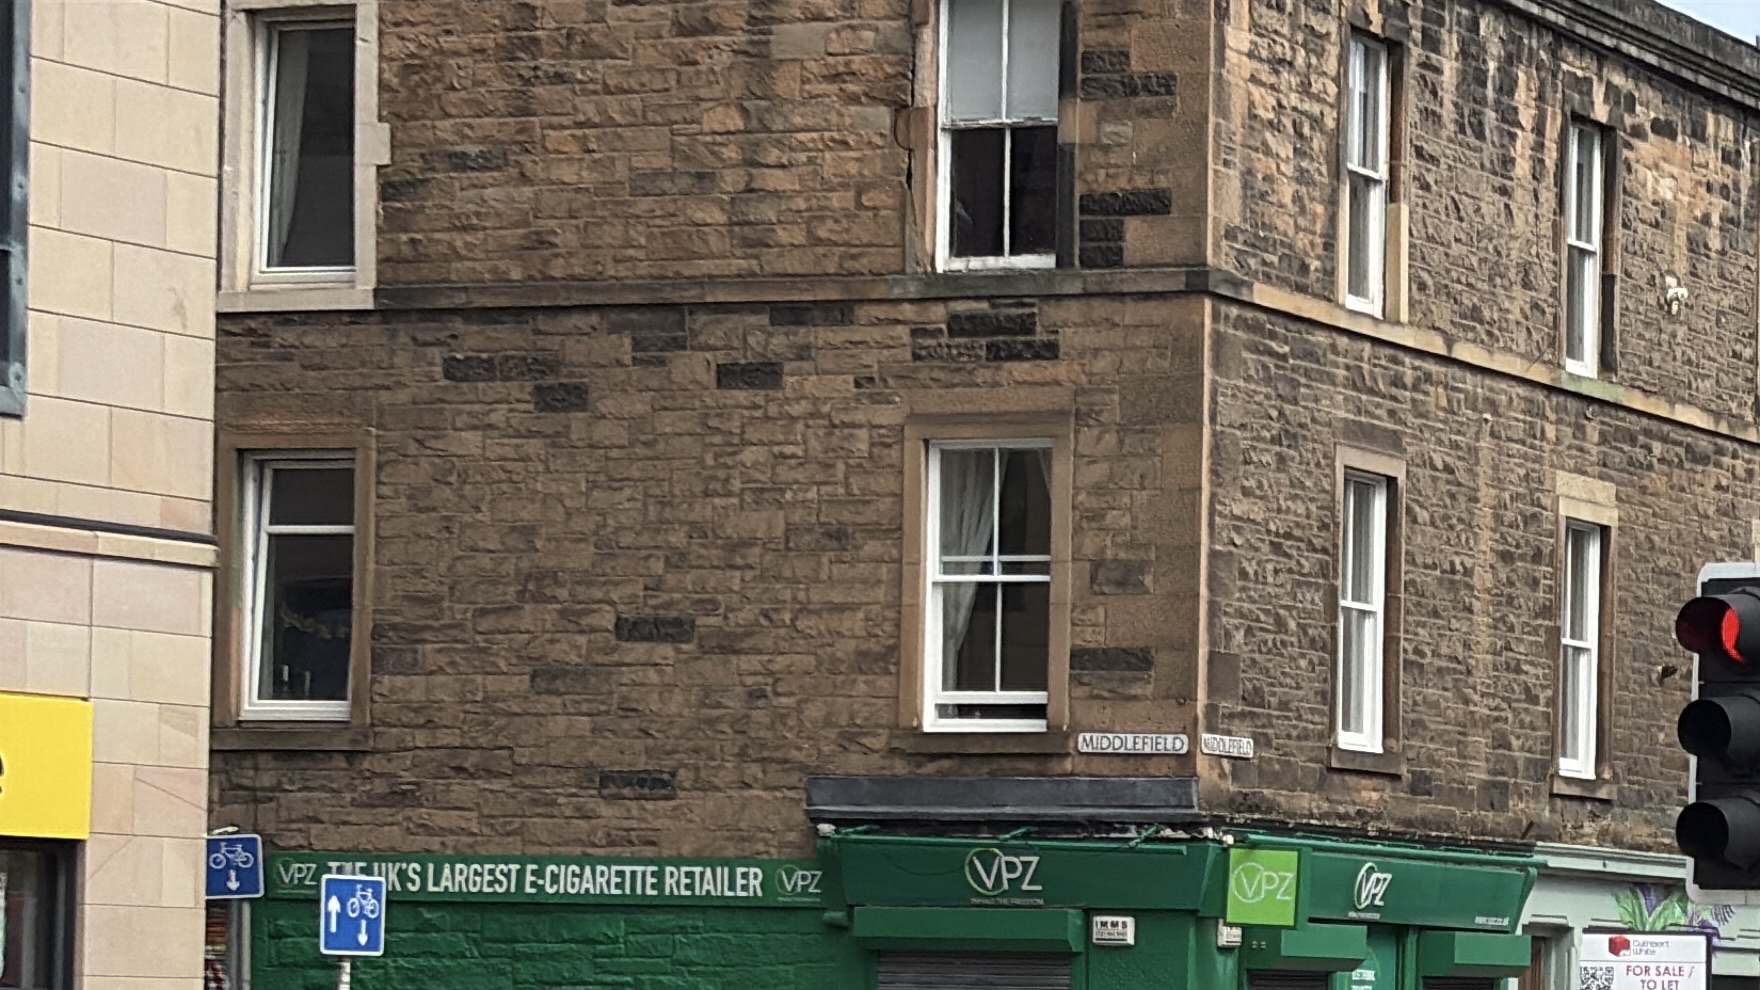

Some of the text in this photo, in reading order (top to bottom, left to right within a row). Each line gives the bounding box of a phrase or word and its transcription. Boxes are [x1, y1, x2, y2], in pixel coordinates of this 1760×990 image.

[1081, 735, 1185, 752] MIDDLEFIELD
[1203, 737, 1253, 756] MIDDLEFIELD
[278, 862, 318, 888] VPZ
[427, 862, 518, 896] LARGEST
[524, 863, 658, 897] E-CIGARETTE
[665, 866, 763, 898] RETAILER
[779, 868, 822, 893] VPZ
[968, 852, 1042, 892] VPZ
[1236, 868, 1294, 902] VPZ
[1359, 866, 1393, 907] VPZ
[1626, 965, 1651, 977] FOR
[1655, 966, 1685, 977] SALE
[1641, 979, 1680, 990] TO LET
